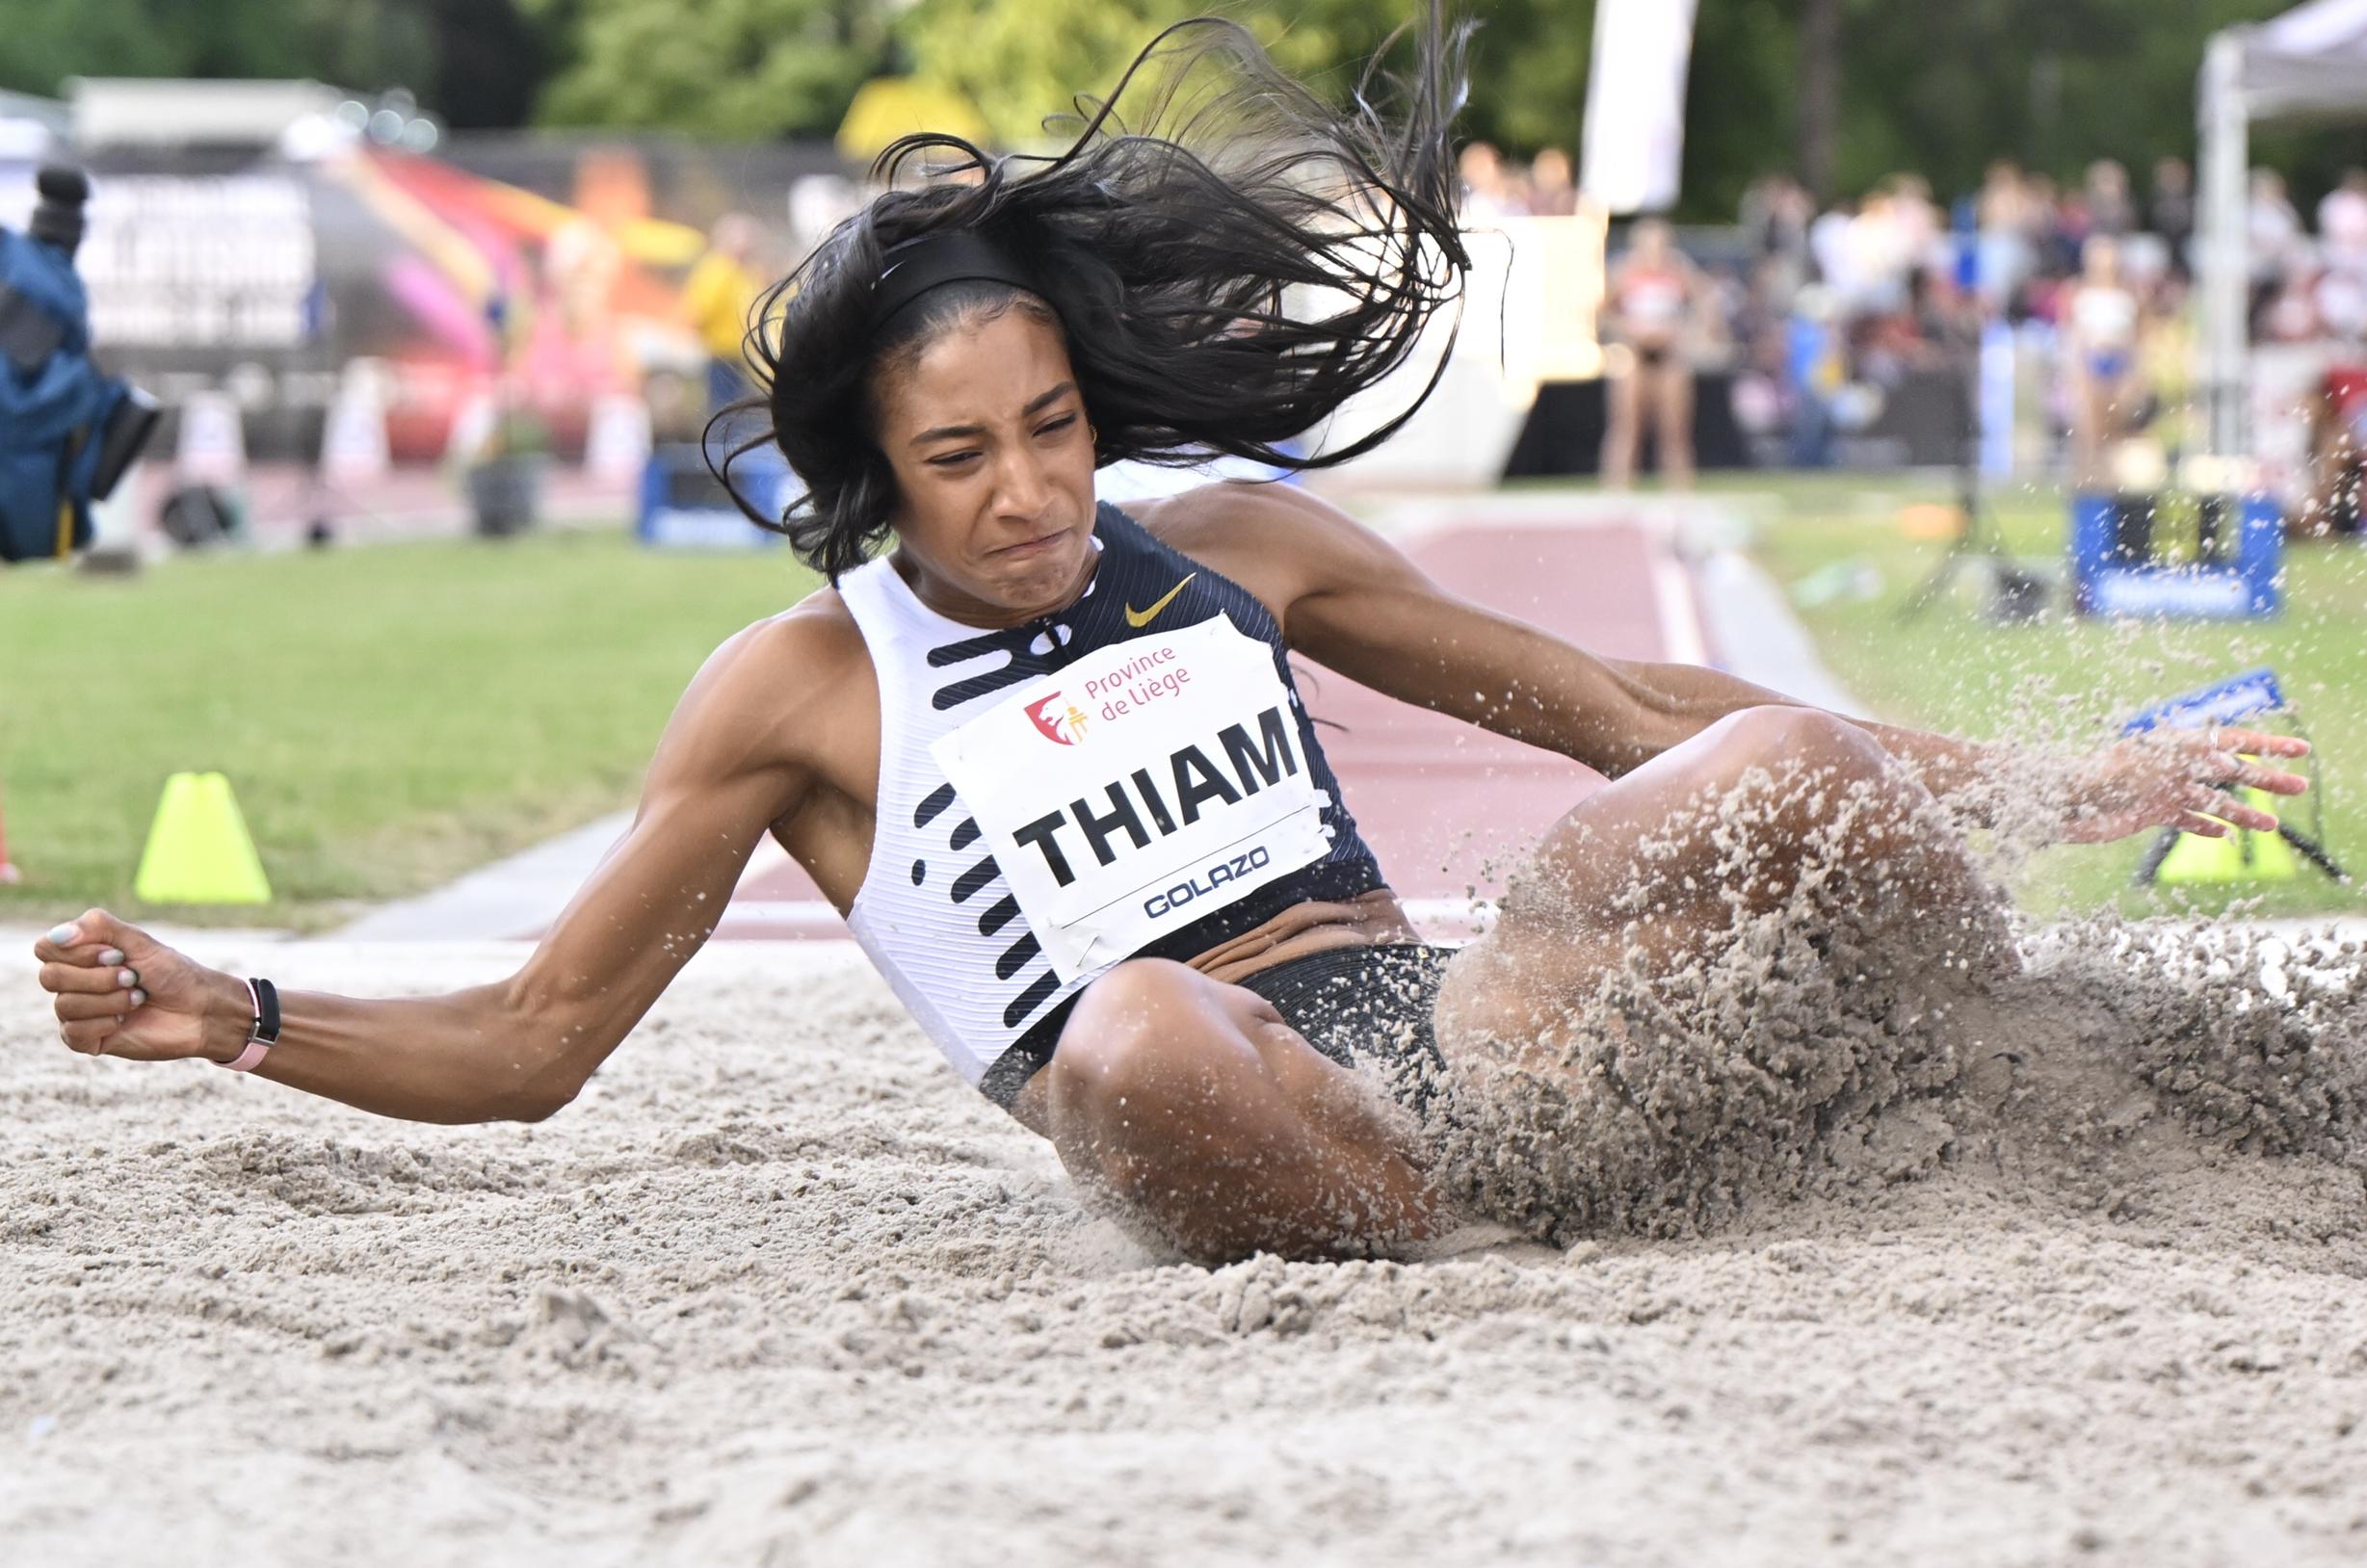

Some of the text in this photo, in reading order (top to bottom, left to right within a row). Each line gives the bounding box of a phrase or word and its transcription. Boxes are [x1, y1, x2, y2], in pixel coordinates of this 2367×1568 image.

[1084, 646, 1176, 700] Province
[1101, 665, 1191, 721] de Liège
[1012, 706, 1298, 888] THIAM
[1144, 846, 1270, 919] GOLAZO
